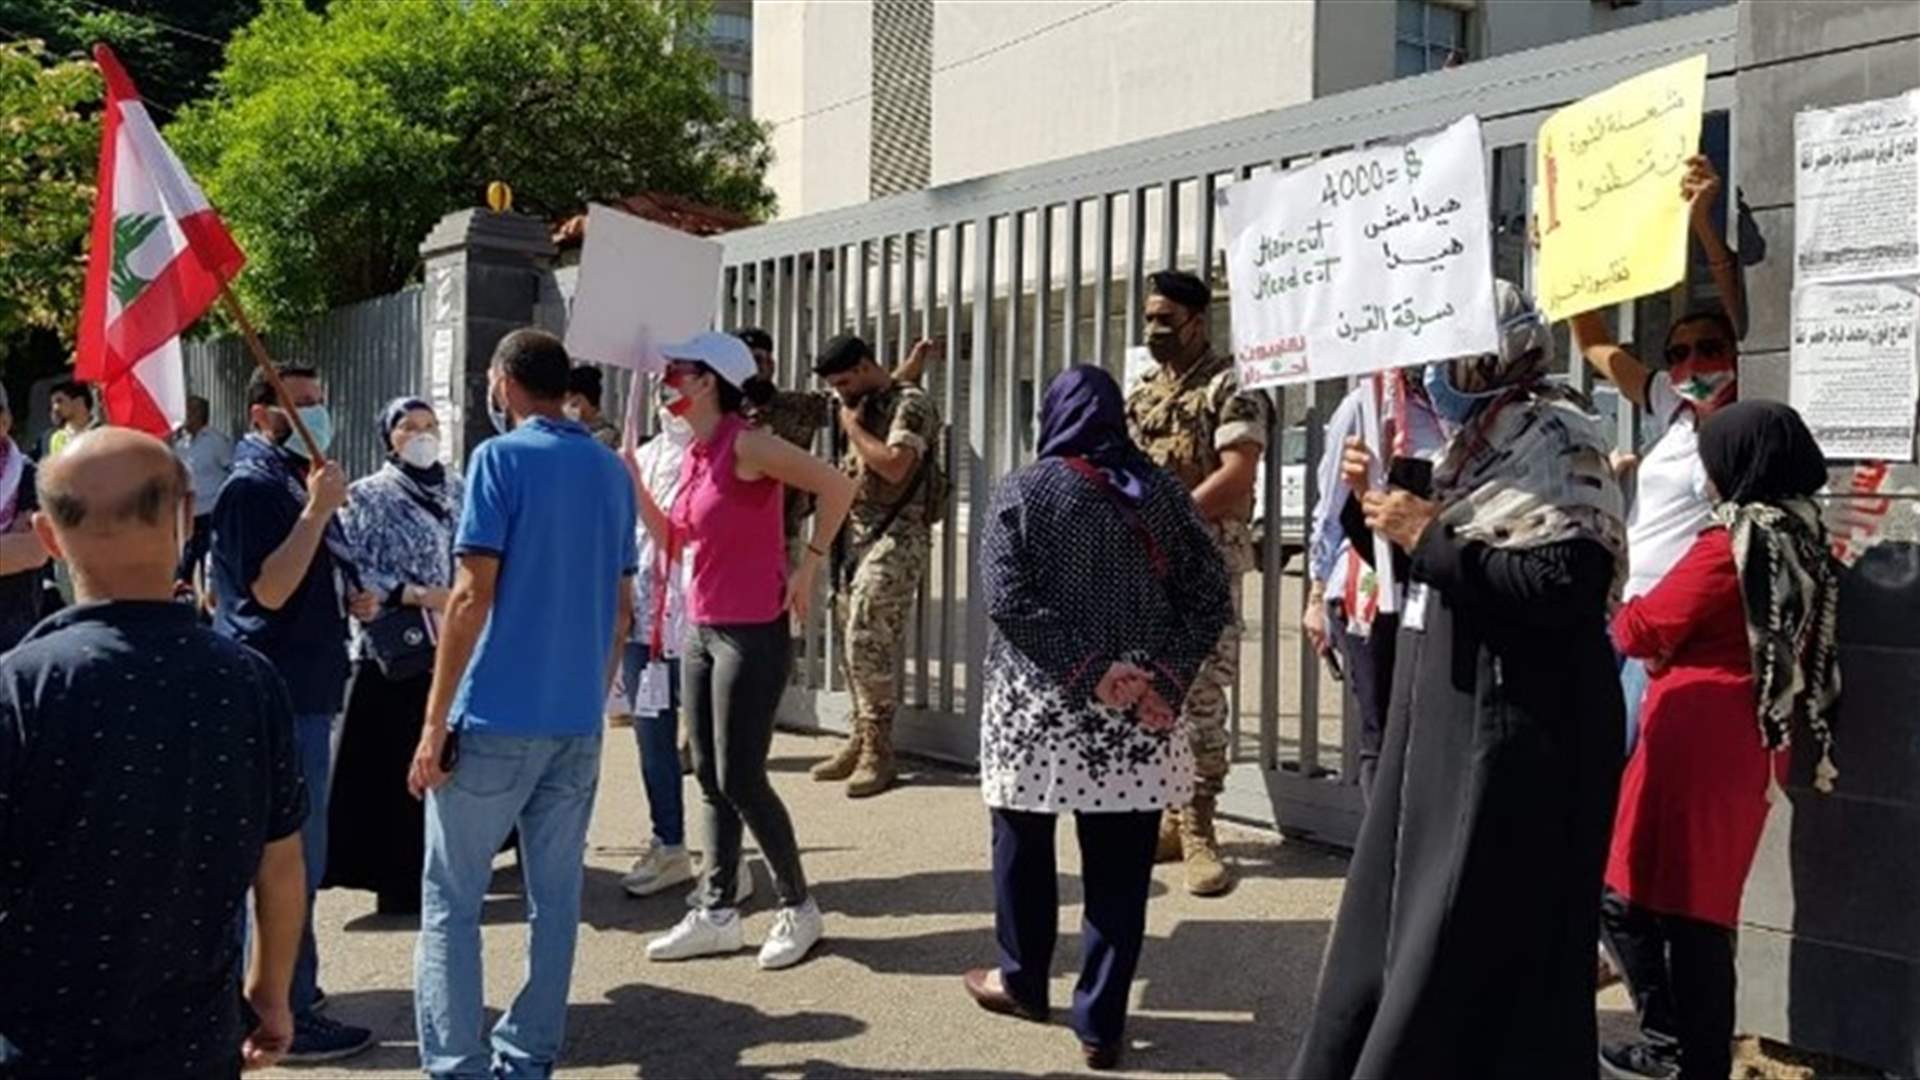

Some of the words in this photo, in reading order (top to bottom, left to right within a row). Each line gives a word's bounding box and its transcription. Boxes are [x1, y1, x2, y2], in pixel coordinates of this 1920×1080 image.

[1364, 205, 1410, 238] مش
[1412, 197, 1461, 225] هيدا
[1383, 237, 1464, 271] هيدا
[1337, 304, 1388, 341] القرن
[1392, 297, 1455, 335] سرقة
